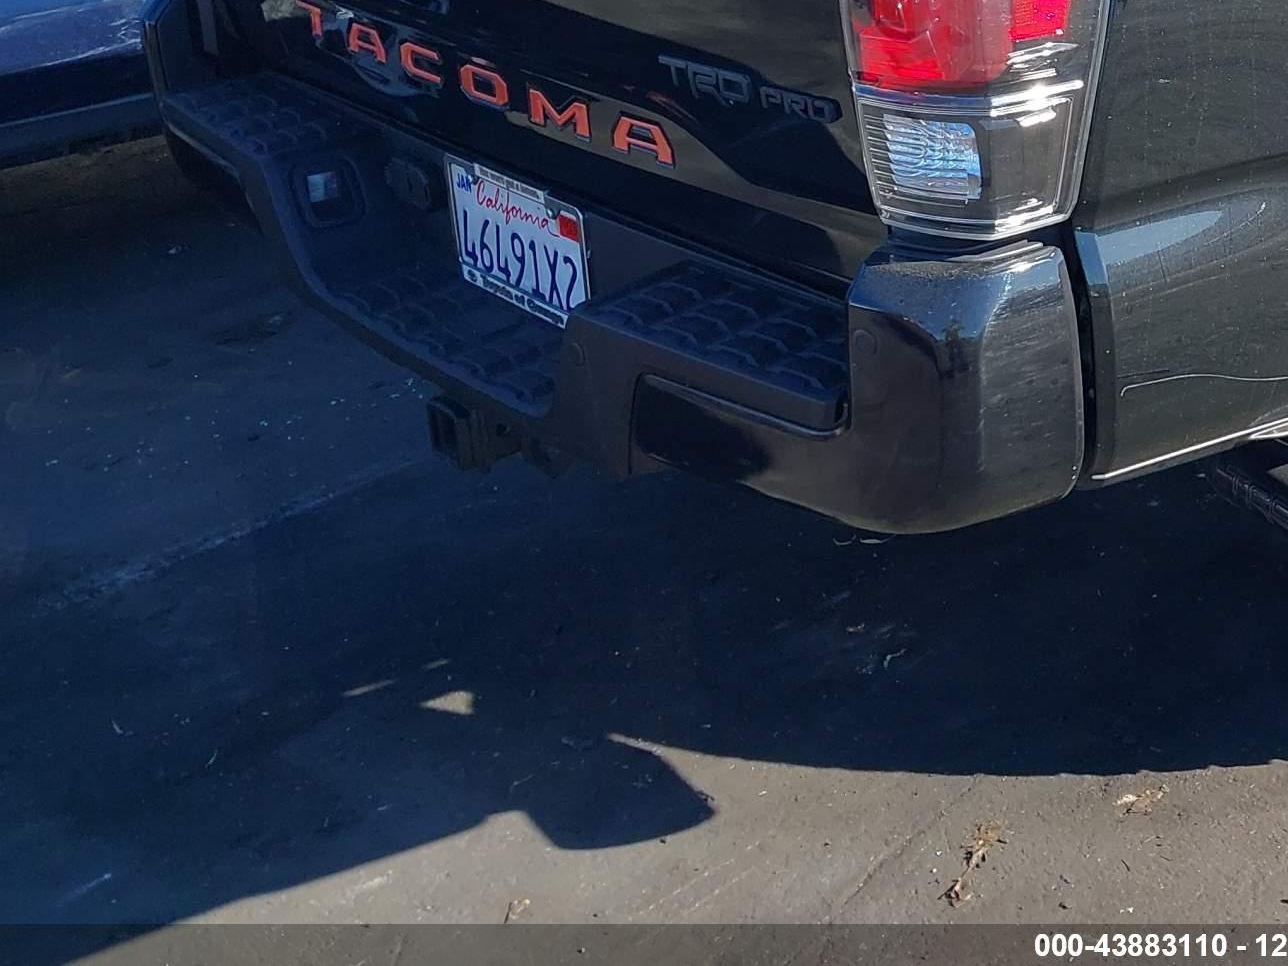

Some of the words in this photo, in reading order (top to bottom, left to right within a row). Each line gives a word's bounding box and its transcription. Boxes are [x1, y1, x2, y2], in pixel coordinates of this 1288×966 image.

[658, 54, 750, 106] TRD
[759, 86, 838, 124] PRO
[456, 172, 472, 194] JAN
[476, 180, 561, 238] California
[463, 209, 578, 313] 46491X2
